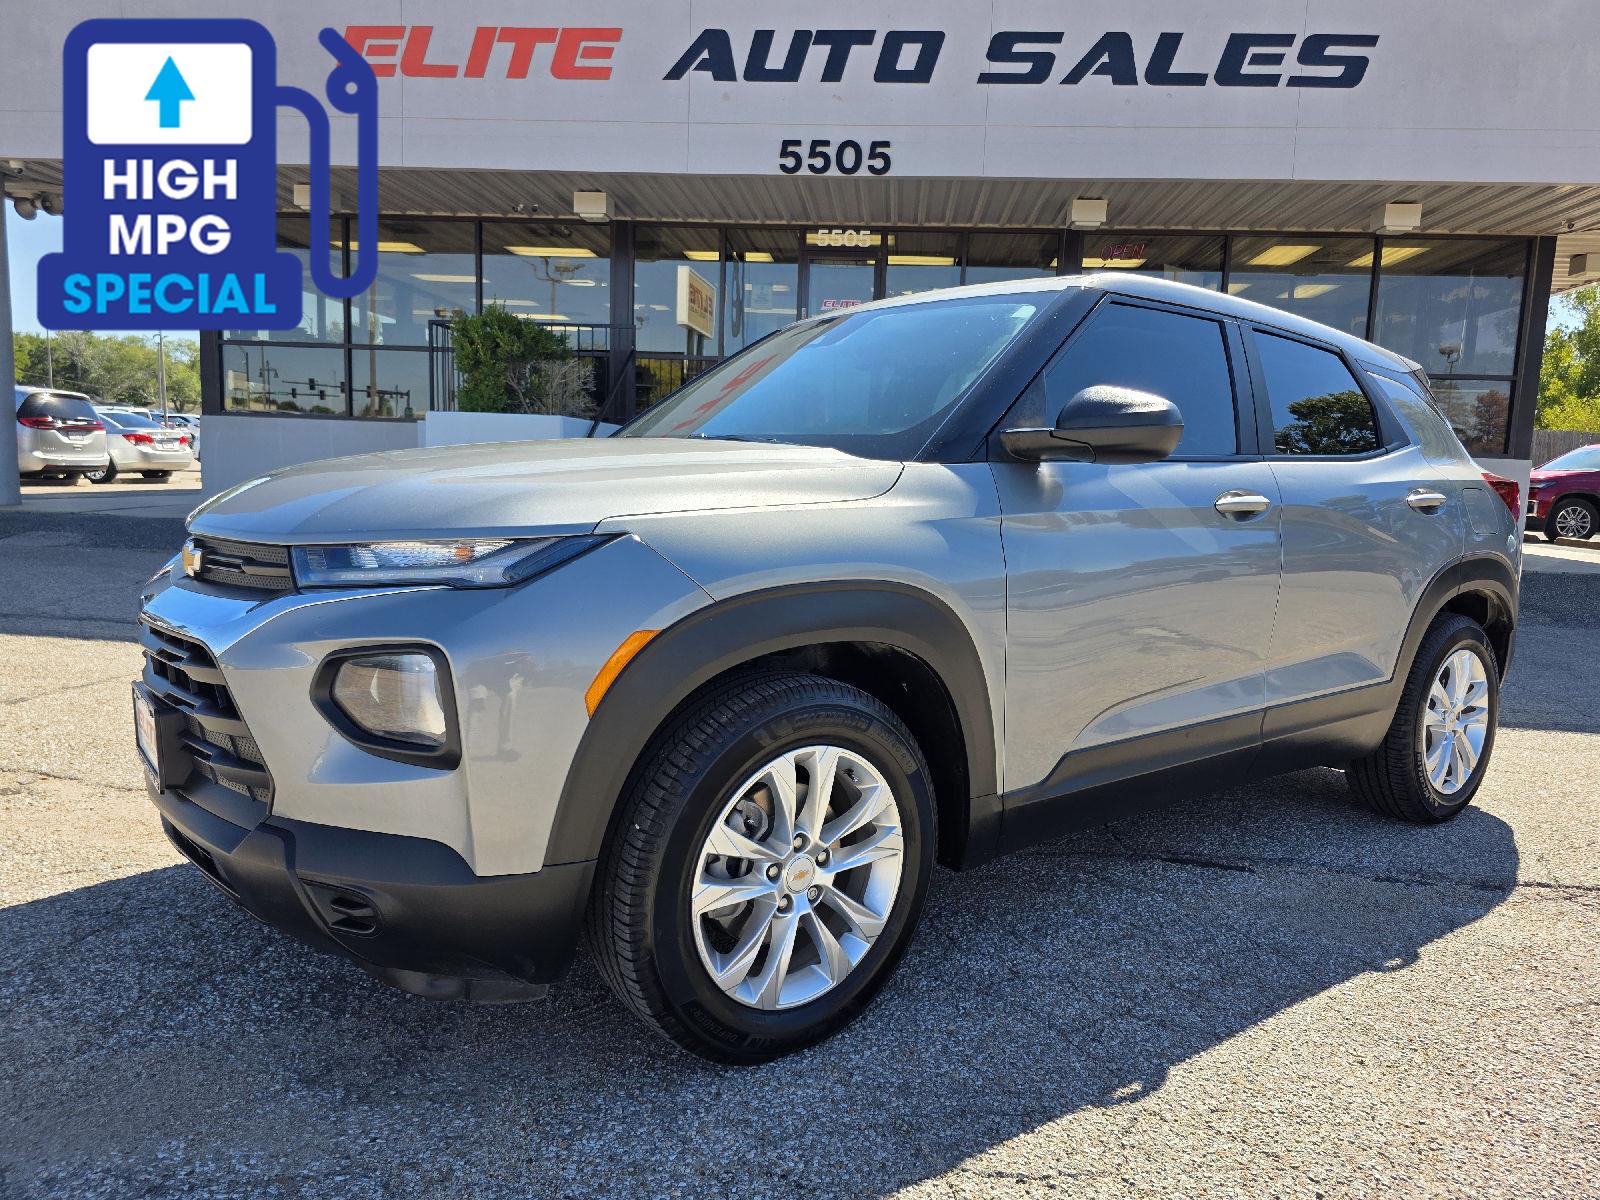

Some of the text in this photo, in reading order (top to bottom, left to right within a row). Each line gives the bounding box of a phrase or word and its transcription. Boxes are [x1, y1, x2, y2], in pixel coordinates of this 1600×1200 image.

[338, 26, 1380, 89] ELITE AUTO SALES
[779, 140, 892, 176] 5505
[817, 230, 871, 247] 5505
[1101, 244, 1145, 261] OPEN
